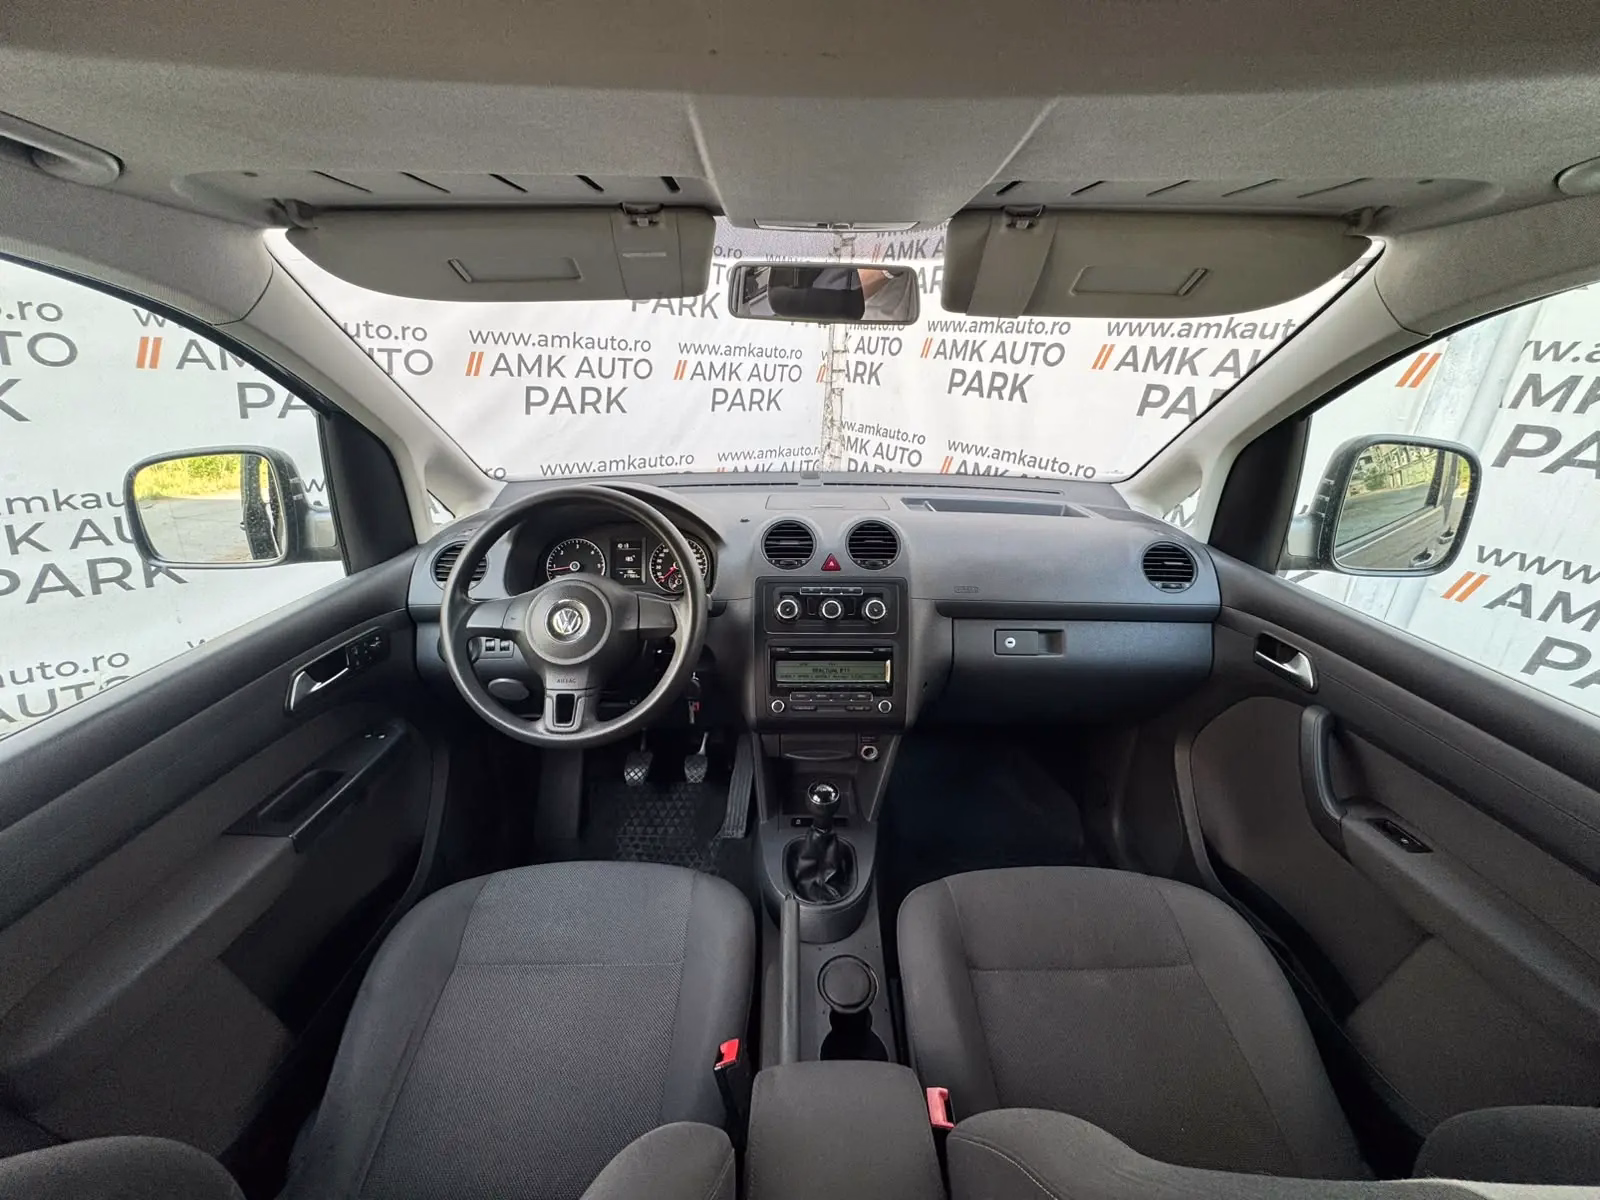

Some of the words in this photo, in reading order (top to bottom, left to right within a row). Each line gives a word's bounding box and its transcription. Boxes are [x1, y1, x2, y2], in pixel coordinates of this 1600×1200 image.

[881, 238, 929, 263] AMK
[0, 301, 63, 322] .ro
[927, 318, 1071, 336] www.amkauto.ro
[469, 329, 652, 352] www.amkauto.ro
[678, 340, 803, 360] www.amkauto.ro
[853, 335, 902, 356] AUTO
[933, 338, 986, 363] AMK
[990, 341, 1065, 367] AUTO
[367, 347, 434, 376] TO
[490, 352, 567, 379] AMK
[574, 356, 653, 380] AUTO
[690, 362, 743, 382] AMK
[747, 363, 802, 383] AUTO
[1113, 345, 1208, 376] AMK
[947, 368, 1035, 403] PARK
[525, 386, 629, 415] PARK
[711, 388, 783, 412] PARK
[1136, 383, 1230, 424] PA
[540, 453, 695, 477] www.amkauto.ro
[873, 441, 922, 467] AUTO
[947, 439, 1097, 480] www.amkauto.ro
[0, 489, 126, 516] mkau
[0, 652, 130, 688] uto.ro
